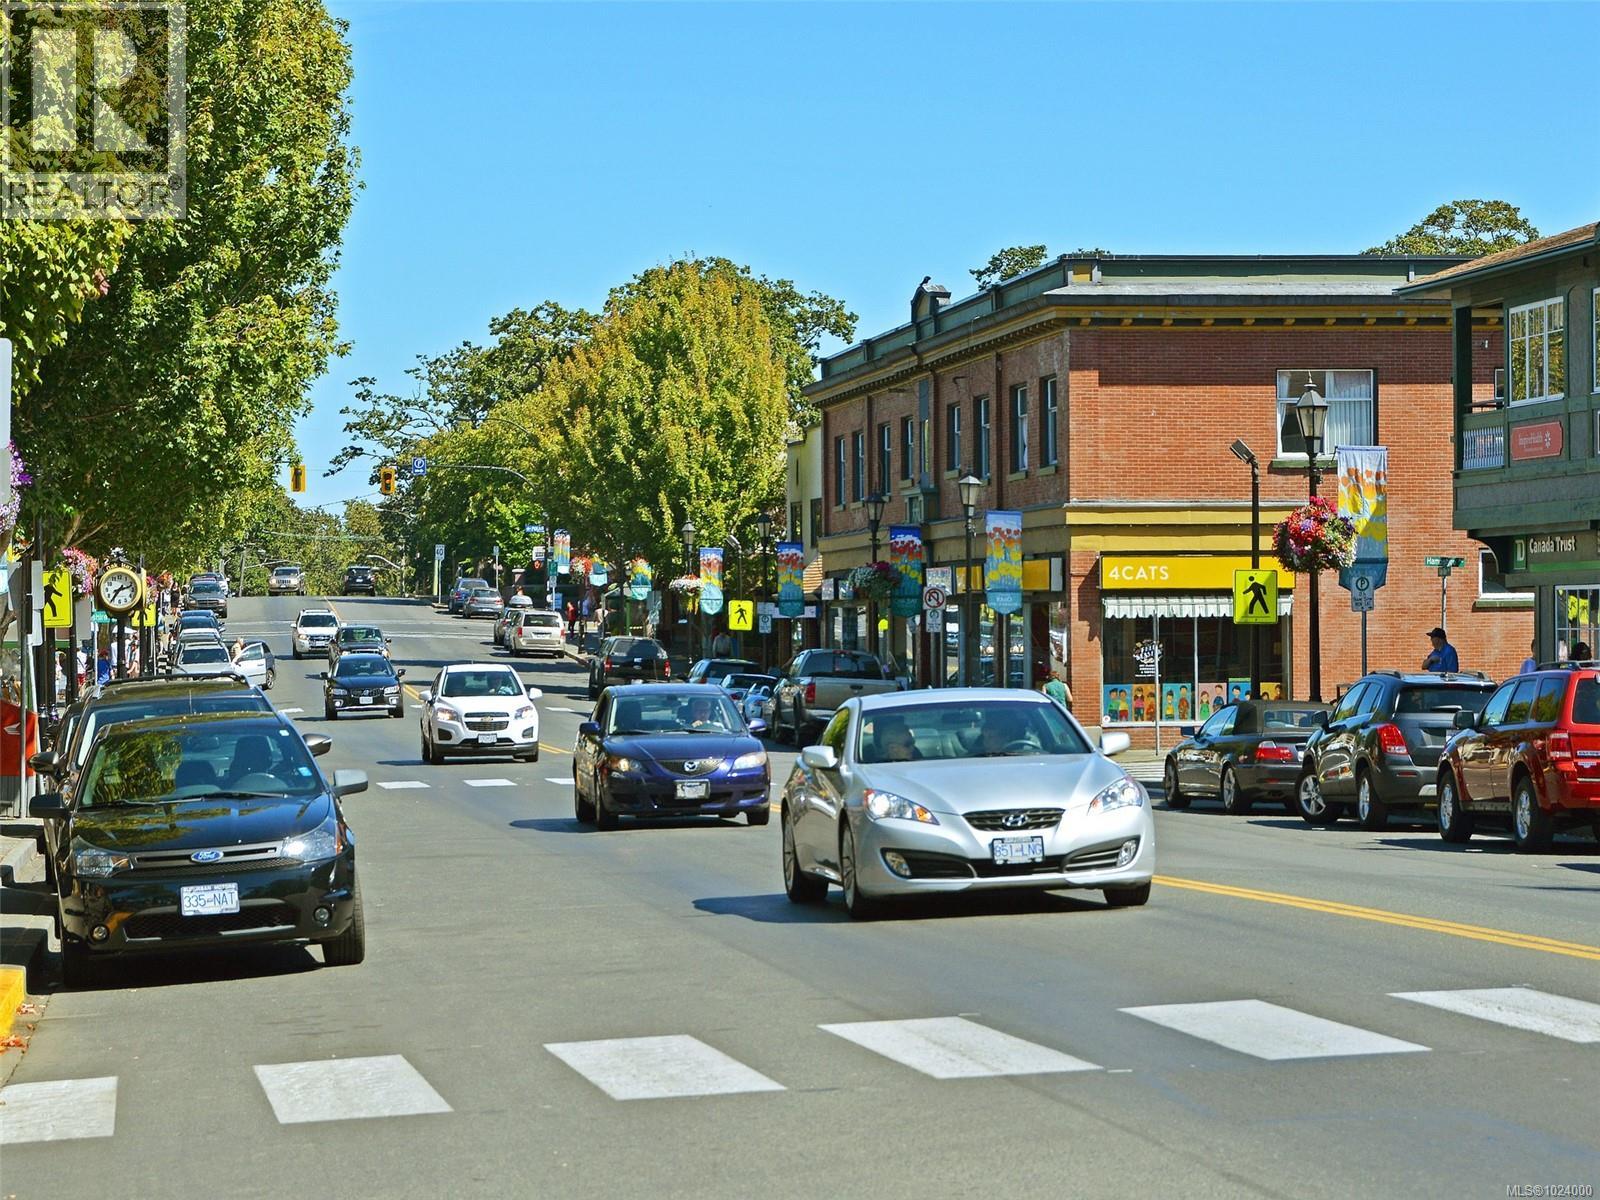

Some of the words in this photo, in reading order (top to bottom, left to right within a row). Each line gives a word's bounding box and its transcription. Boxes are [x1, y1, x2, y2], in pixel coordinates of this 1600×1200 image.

[1529, 536, 1555, 554] Canada
[1556, 535, 1576, 552] Trust
[1108, 565, 1169, 581] 4CATS
[184, 891, 235, 908] 335-NAT
